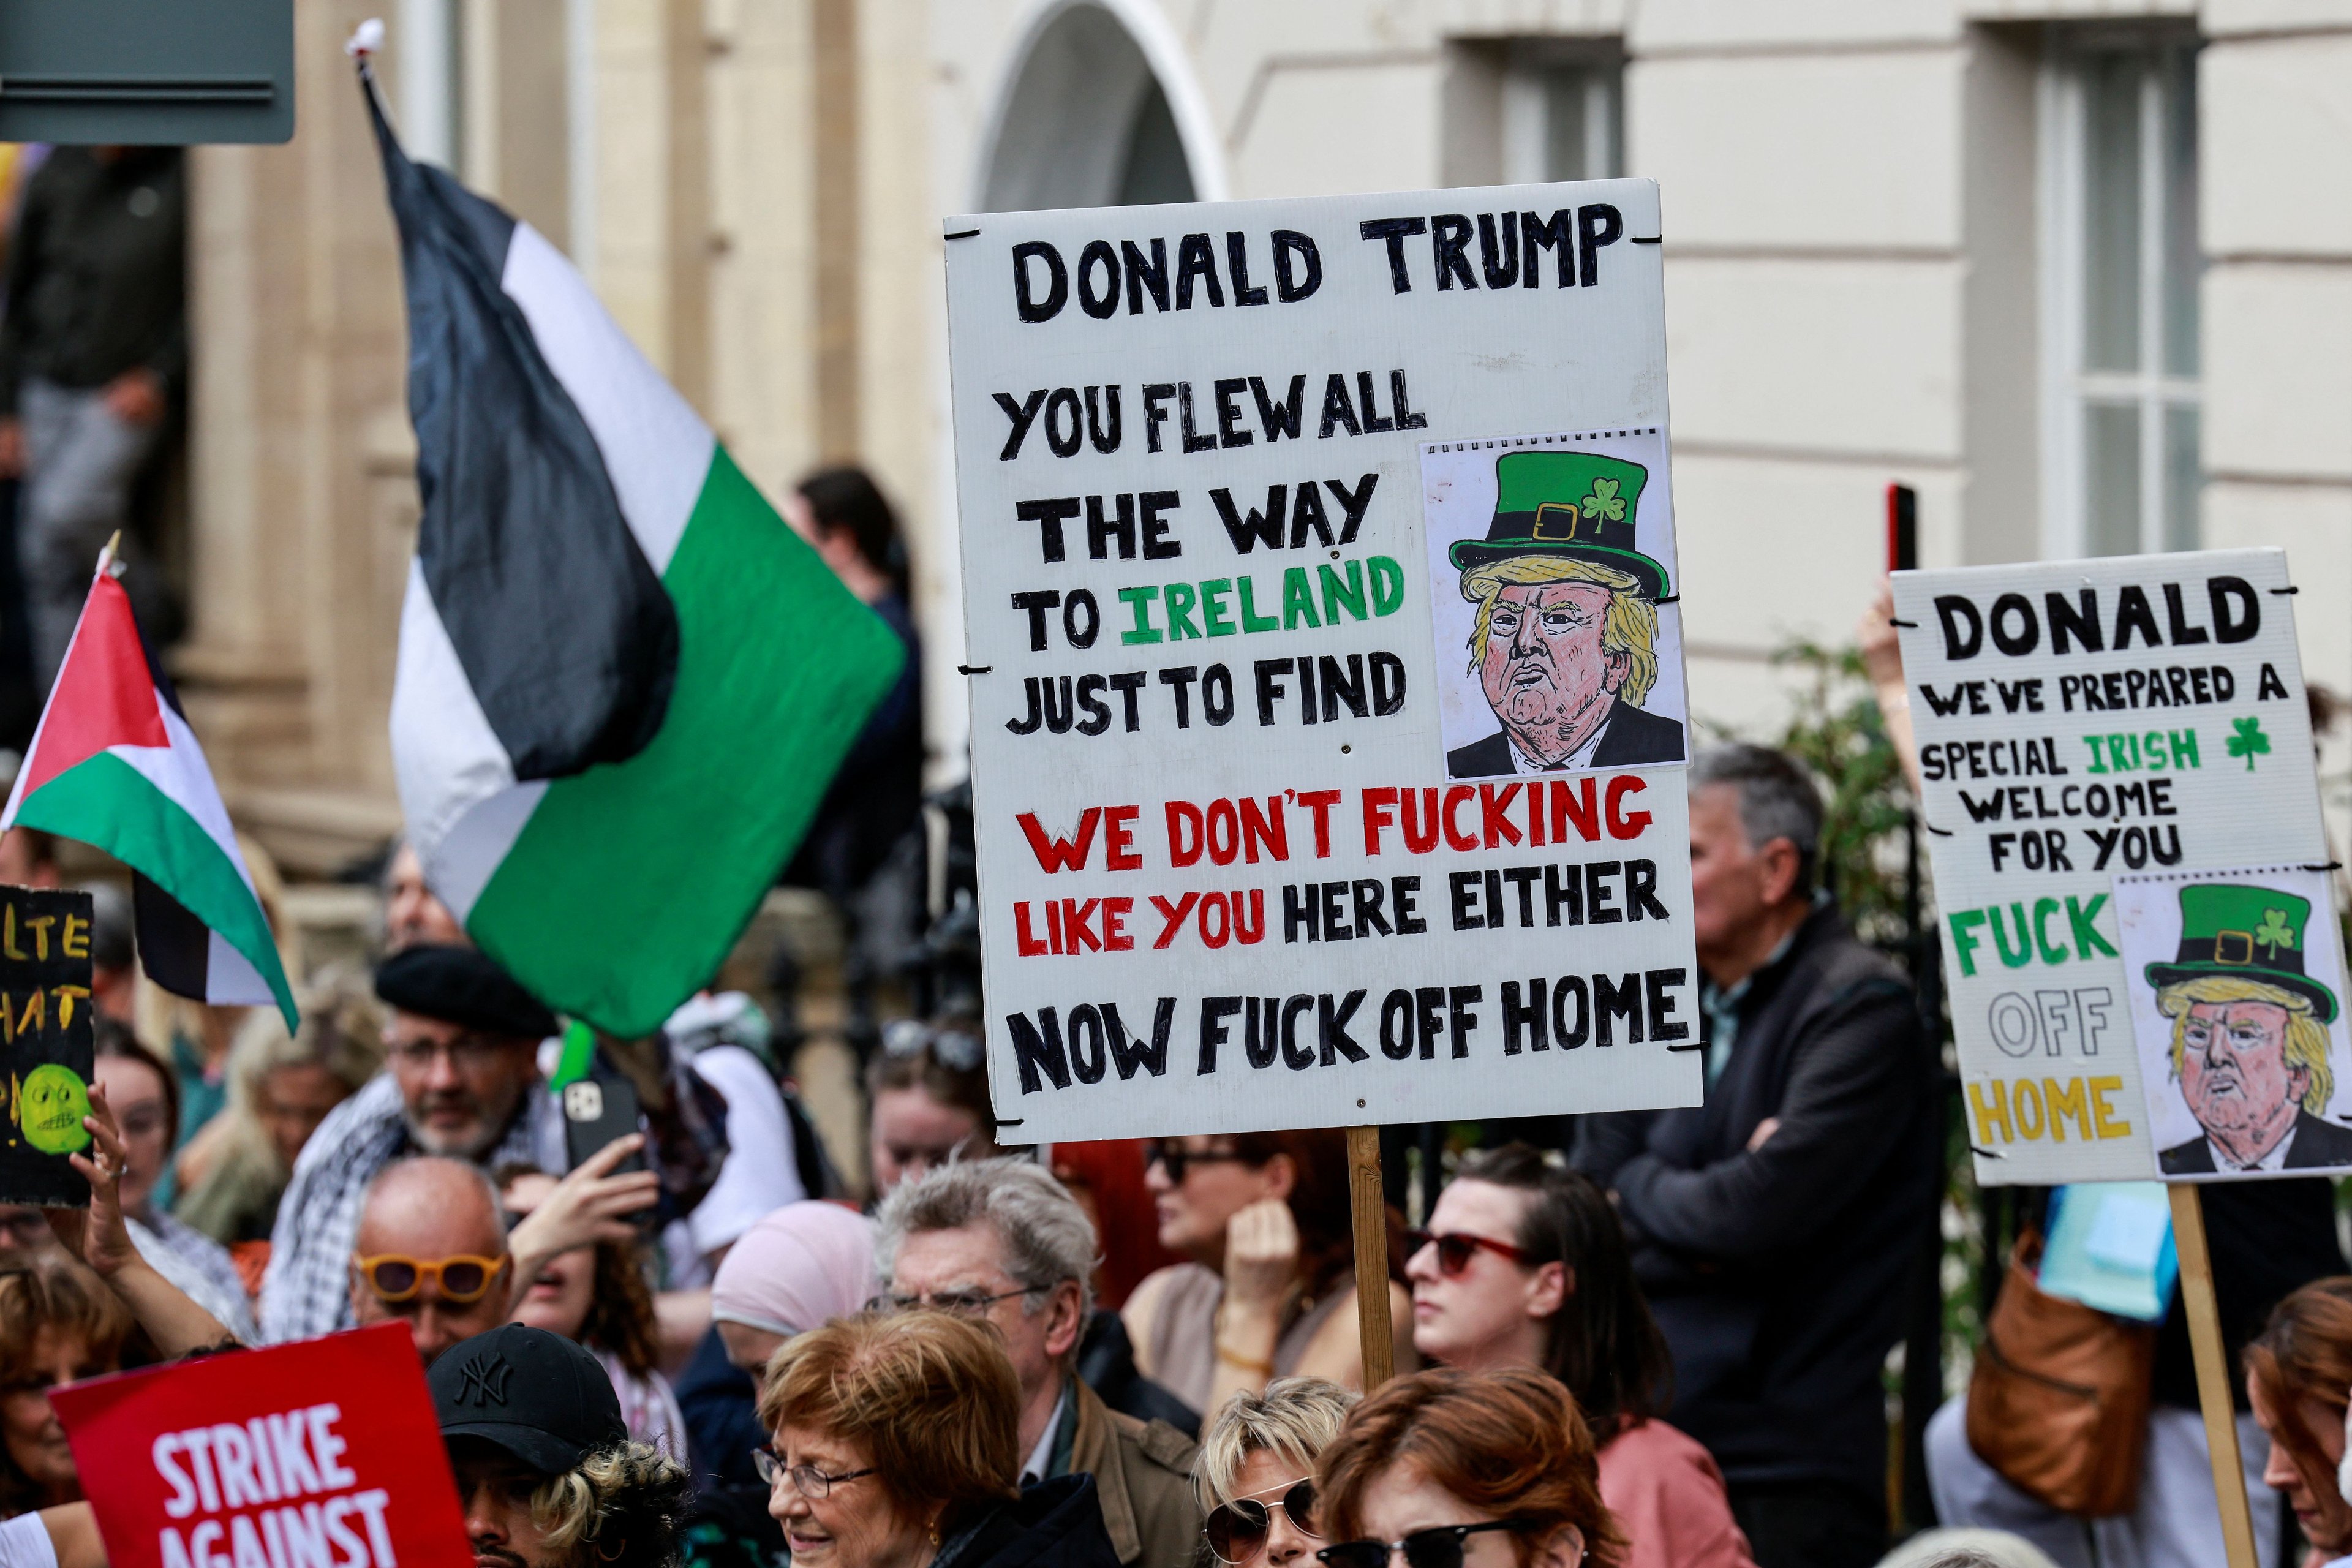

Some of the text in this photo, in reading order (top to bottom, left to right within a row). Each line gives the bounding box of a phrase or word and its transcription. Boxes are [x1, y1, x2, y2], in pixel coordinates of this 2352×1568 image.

[1012, 204, 1623, 323] DONALD TRUMP
[992, 369, 1428, 461] YOU FLEW ALL
[1016, 474, 1379, 564] THE WAY
[1011, 556, 1404, 652] TO IRELAND
[1934, 576, 2260, 660] DONALD
[1005, 652, 1406, 736] JUST TO FIND
[1919, 663, 2288, 717] WE'VE PREPARED A
[1921, 729, 2200, 780] SPECIAL IRISH
[1016, 775, 1652, 873] WE DON'T FUCKING
[1959, 778, 2177, 823] WELCOME
[1990, 825, 2182, 872] FOR YOU
[1014, 859, 1670, 957] LIKE YOU HERE EITHER
[1948, 894, 2119, 976] FUCK
[1006, 968, 1691, 1095] NOW FUCK OFF HOME
[1988, 987, 2113, 1058] OFF
[1969, 1077, 2130, 1144] HOME
[151, 1402, 356, 1518] STRIKE
